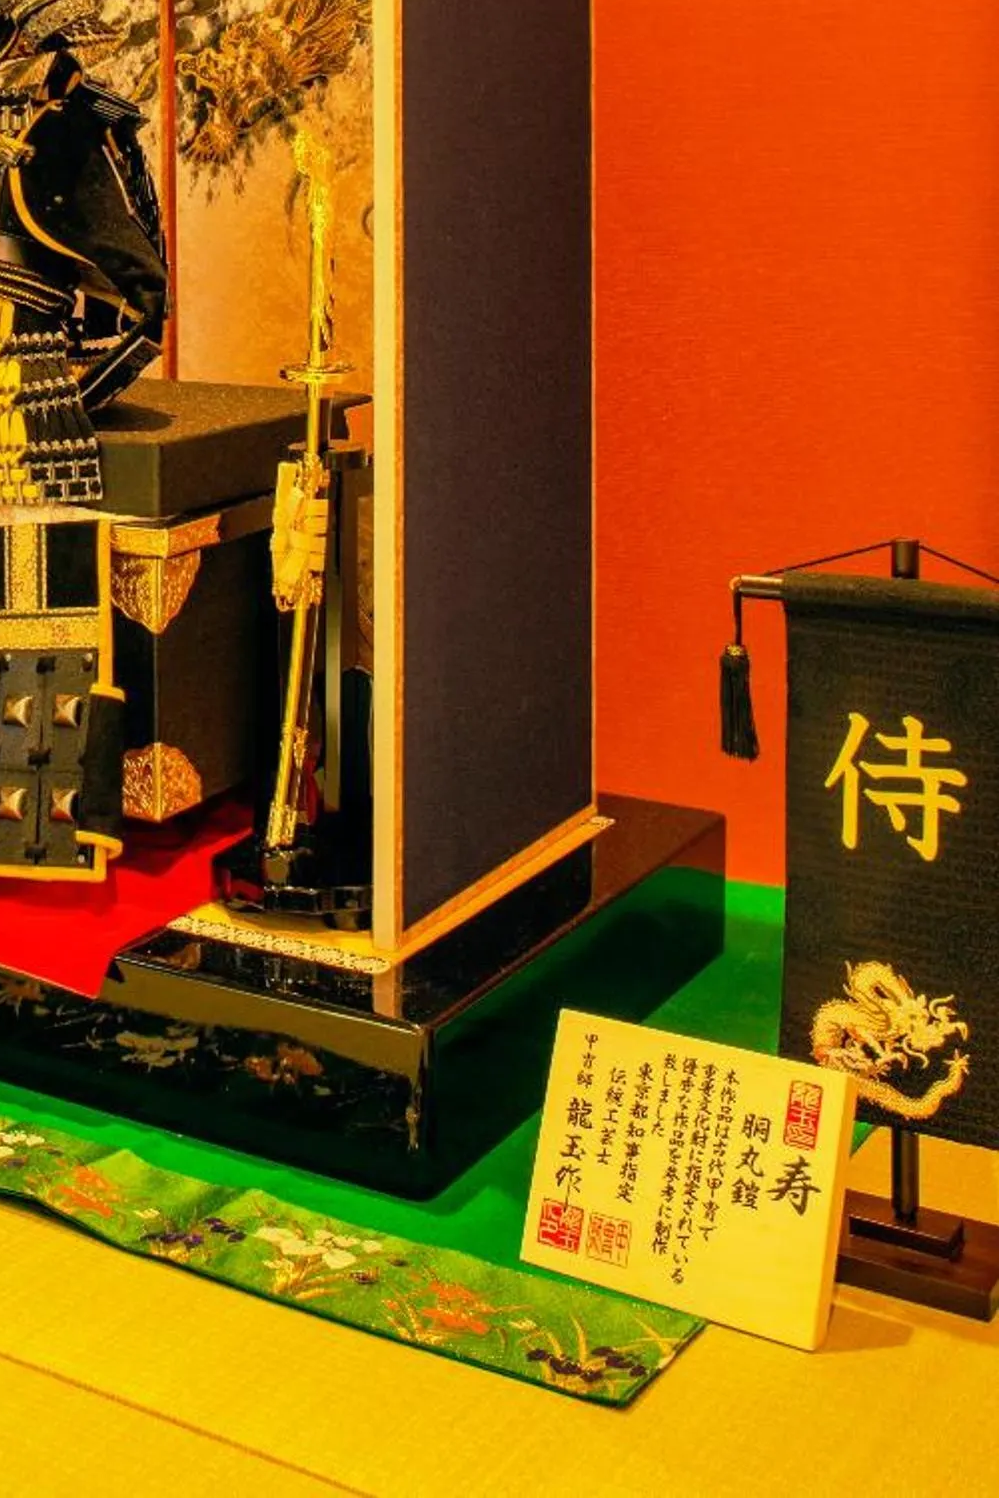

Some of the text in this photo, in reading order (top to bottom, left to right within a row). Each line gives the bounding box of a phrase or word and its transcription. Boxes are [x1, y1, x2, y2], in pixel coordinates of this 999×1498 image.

[824, 712, 968, 862] 侍
[617, 1062, 654, 1204] 東京都知事指定
[731, 1113, 771, 1211] 胴丸鎧
[767, 1156, 821, 1216] 寿
